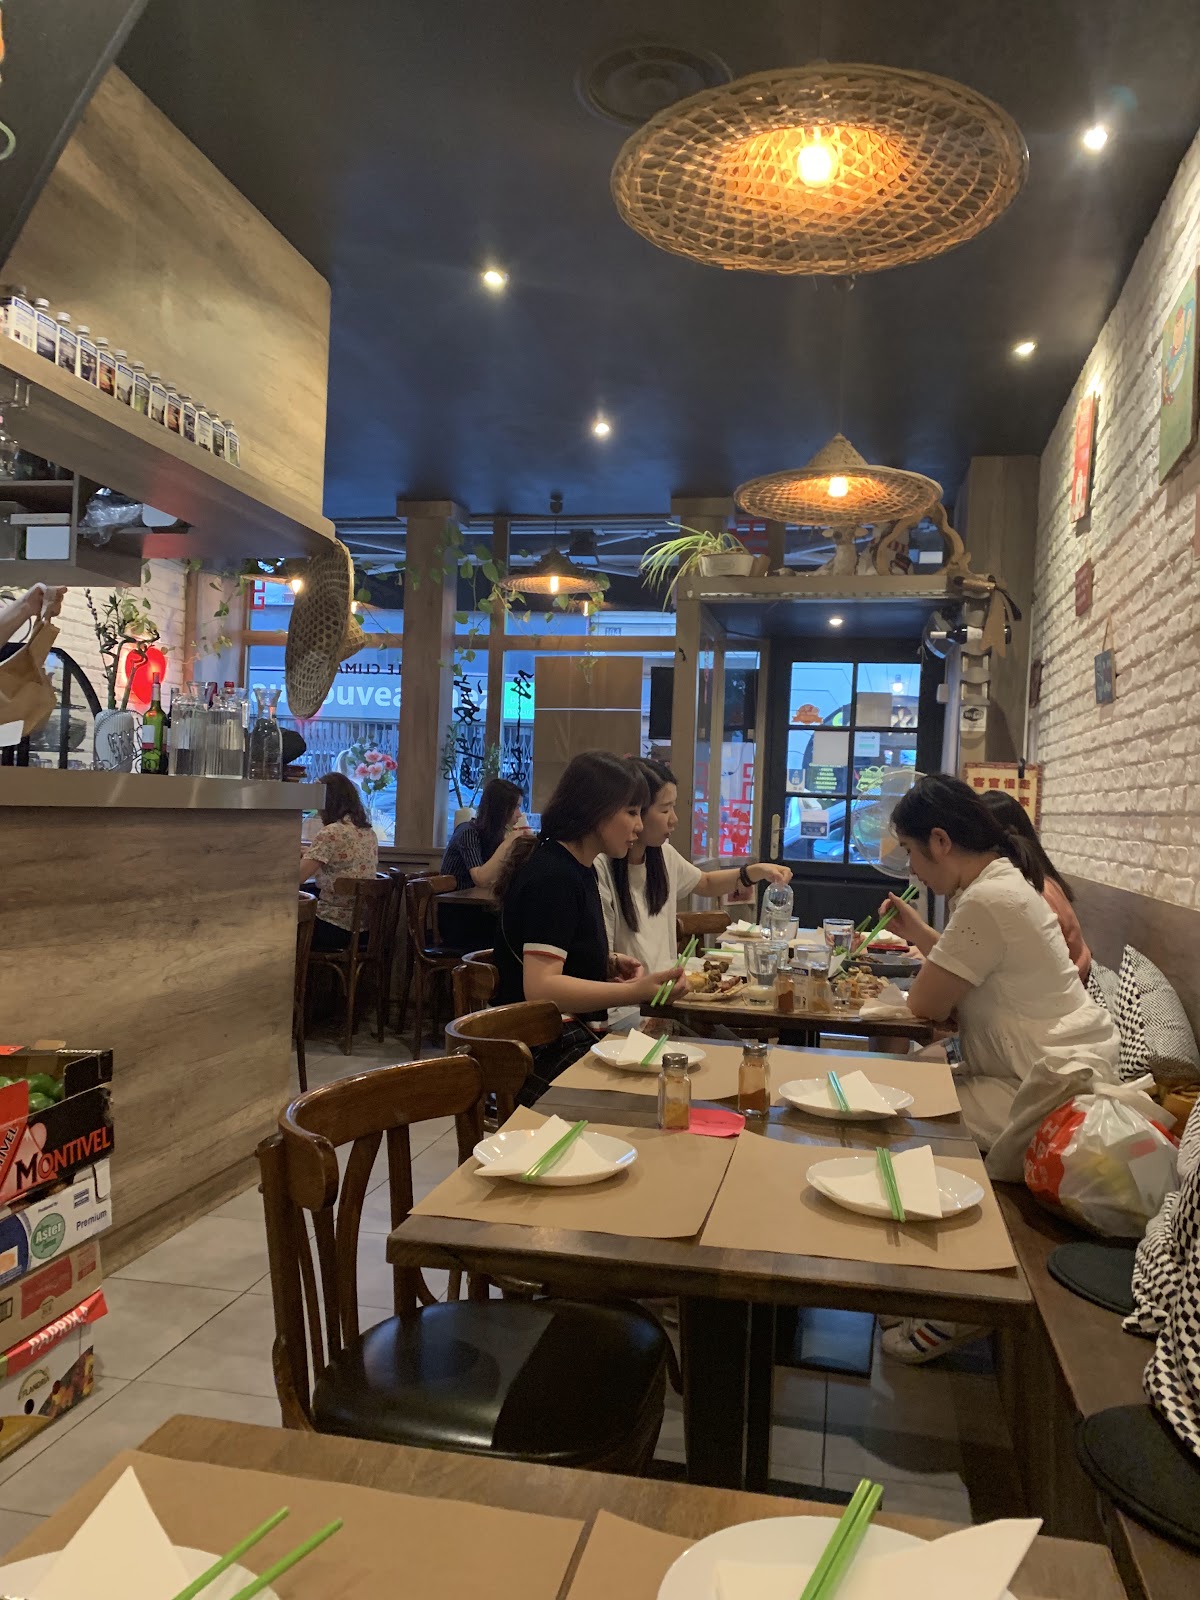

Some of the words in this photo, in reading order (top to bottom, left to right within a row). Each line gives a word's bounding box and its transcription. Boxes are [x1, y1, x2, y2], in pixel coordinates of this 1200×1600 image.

[15, 1126, 112, 1190] MONTIVEL
[76, 1209, 107, 1231] Premium
[35, 1222, 62, 1244] Aster
